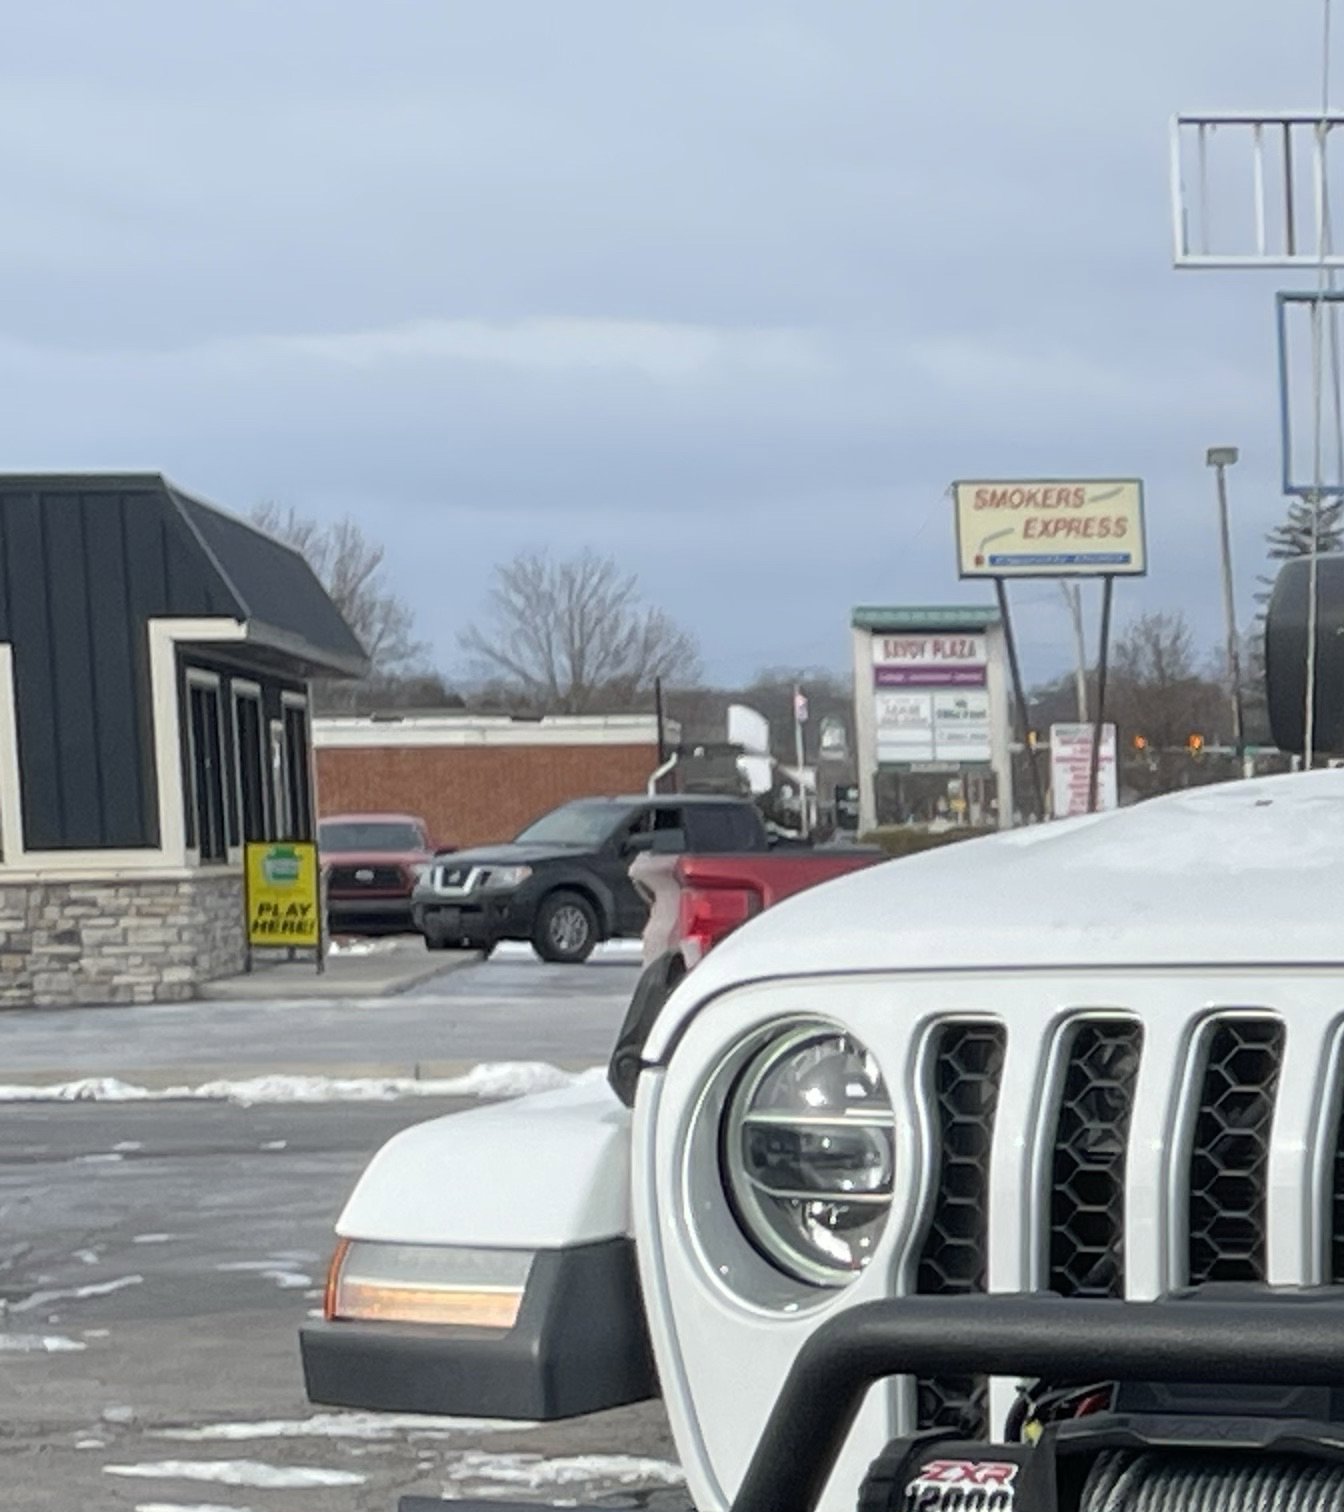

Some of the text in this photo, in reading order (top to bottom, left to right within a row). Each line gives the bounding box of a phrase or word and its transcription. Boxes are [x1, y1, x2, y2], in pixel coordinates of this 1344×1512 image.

[974, 487, 1086, 511] SMOKERS
[1022, 516, 1129, 540] EXPRESS
[932, 639, 977, 660] PLAZA
[257, 902, 312, 917] PLAY
[920, 1462, 1015, 1485] ZXR
